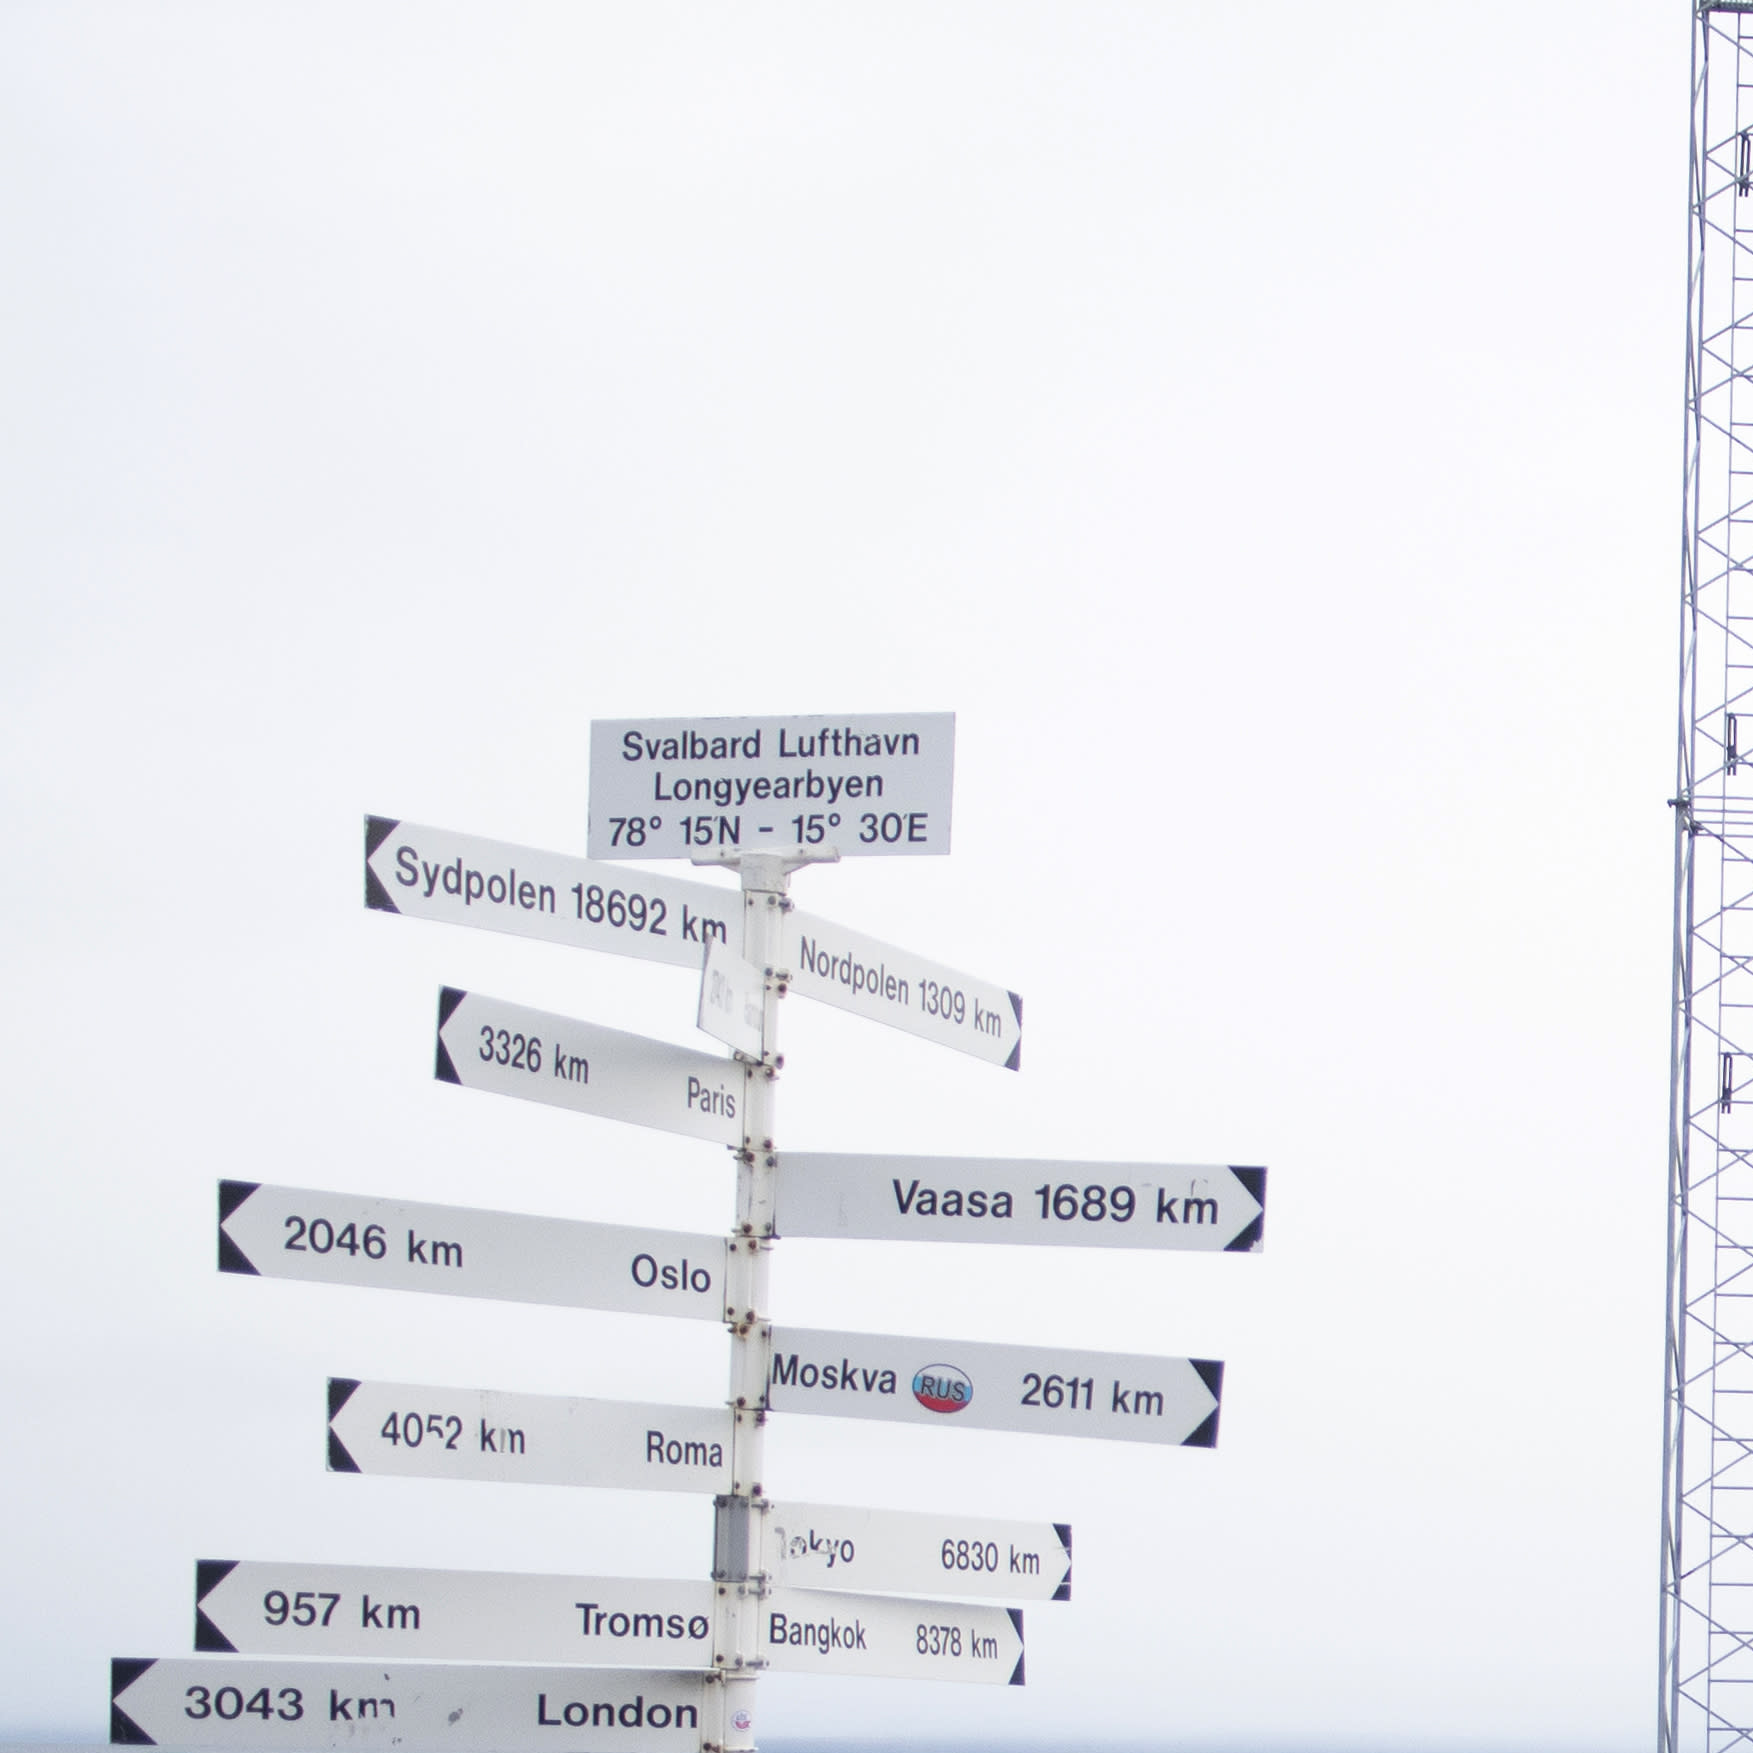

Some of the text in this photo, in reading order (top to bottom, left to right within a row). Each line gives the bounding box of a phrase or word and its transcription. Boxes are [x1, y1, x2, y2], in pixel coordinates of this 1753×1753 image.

[622, 727, 919, 761] Svalbard Lufthavn
[655, 769, 883, 806] Longyearbyen
[608, 816, 662, 846] 78°
[792, 813, 841, 844] 15°
[395, 846, 727, 945] Sydpolen 18692 km
[800, 935, 1002, 1038] Nordpolen 1309 km
[479, 1025, 736, 1119] 3326 km Paris
[893, 1179, 1219, 1225] Vaasa 1689 km
[283, 1215, 712, 1293] 2046 km Oslo
[772, 1353, 1165, 1417] Moskva RUS 2611 km
[381, 1411, 723, 1468] 4052 km Roma
[941, 1538, 999, 1573] 6830
[1010, 1544, 1040, 1575] km
[263, 1590, 710, 1640] 957 km Tromsø
[769, 1613, 998, 1659] Bangkok 8378 km
[184, 1686, 698, 1729] 3043 km London
